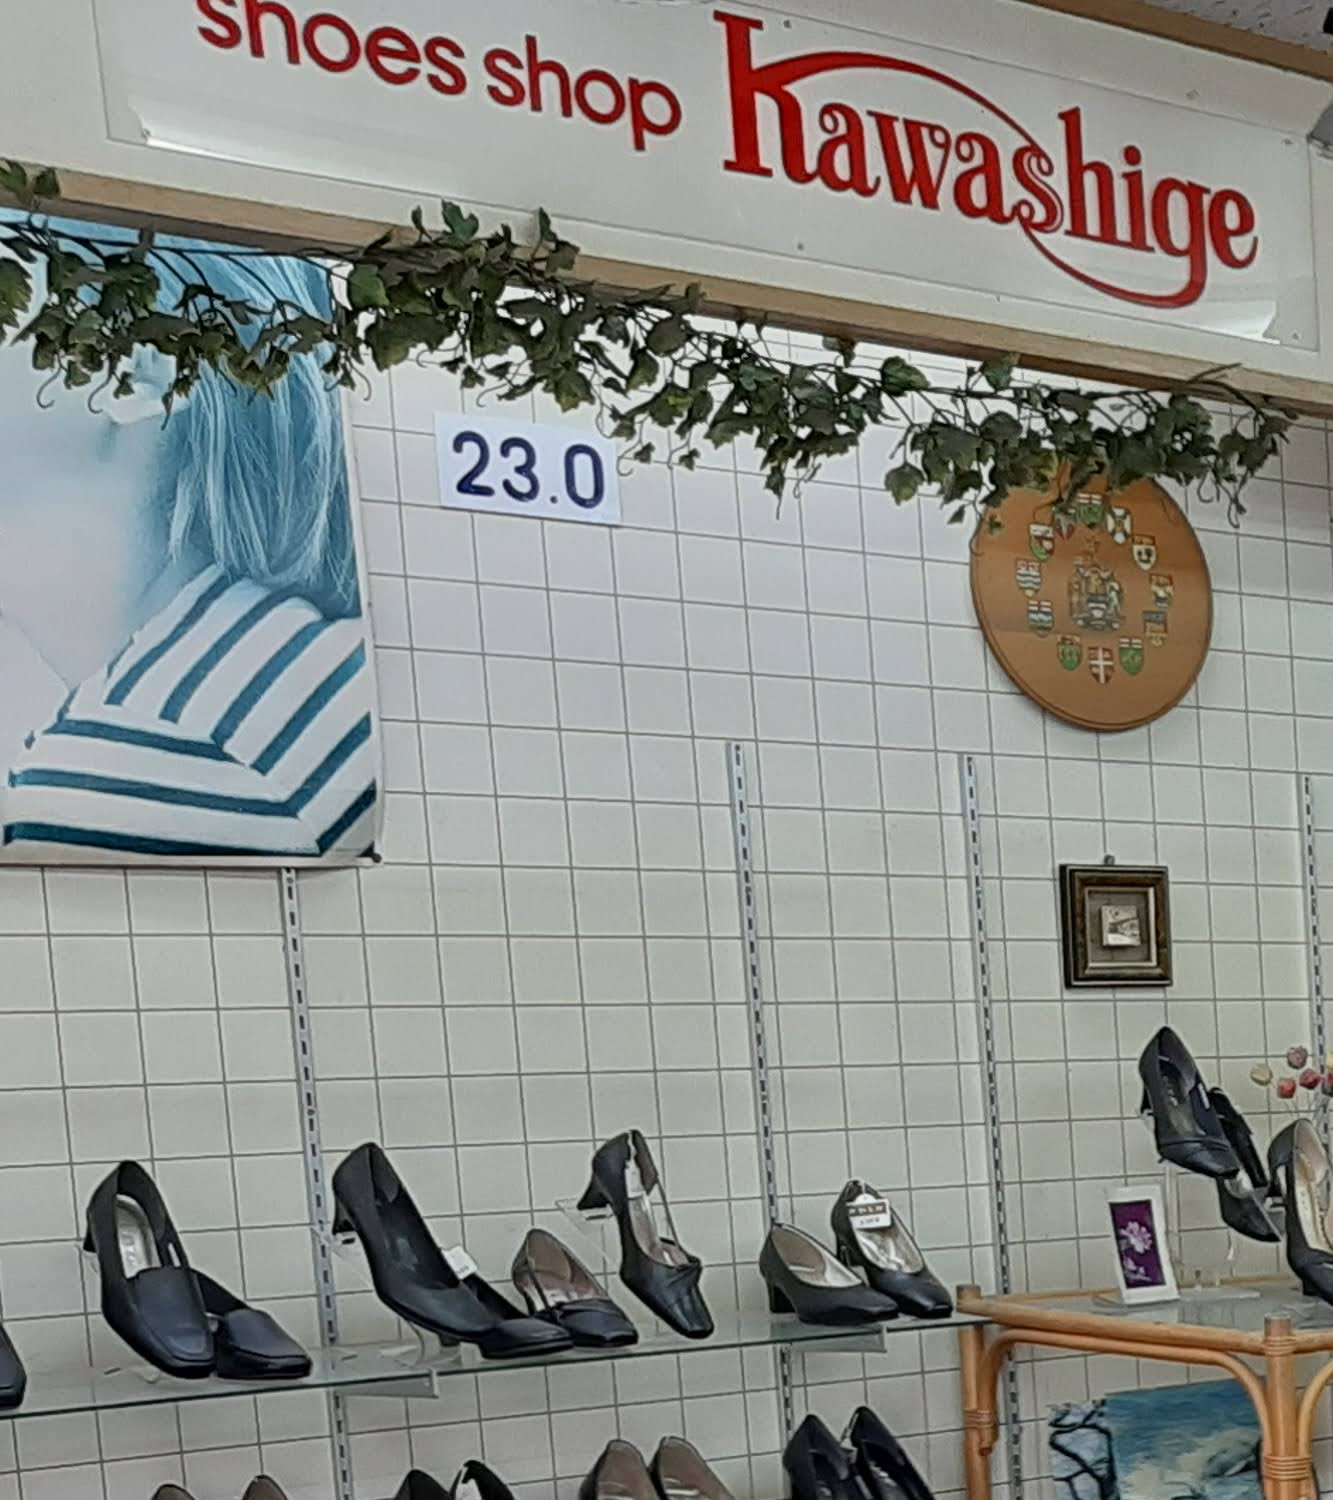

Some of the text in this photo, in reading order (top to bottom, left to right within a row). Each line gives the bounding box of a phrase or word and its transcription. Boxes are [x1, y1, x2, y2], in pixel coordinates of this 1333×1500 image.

[197, 0, 1259, 309] shoes shop Kawashige
[452, 430, 605, 509] 23.0
